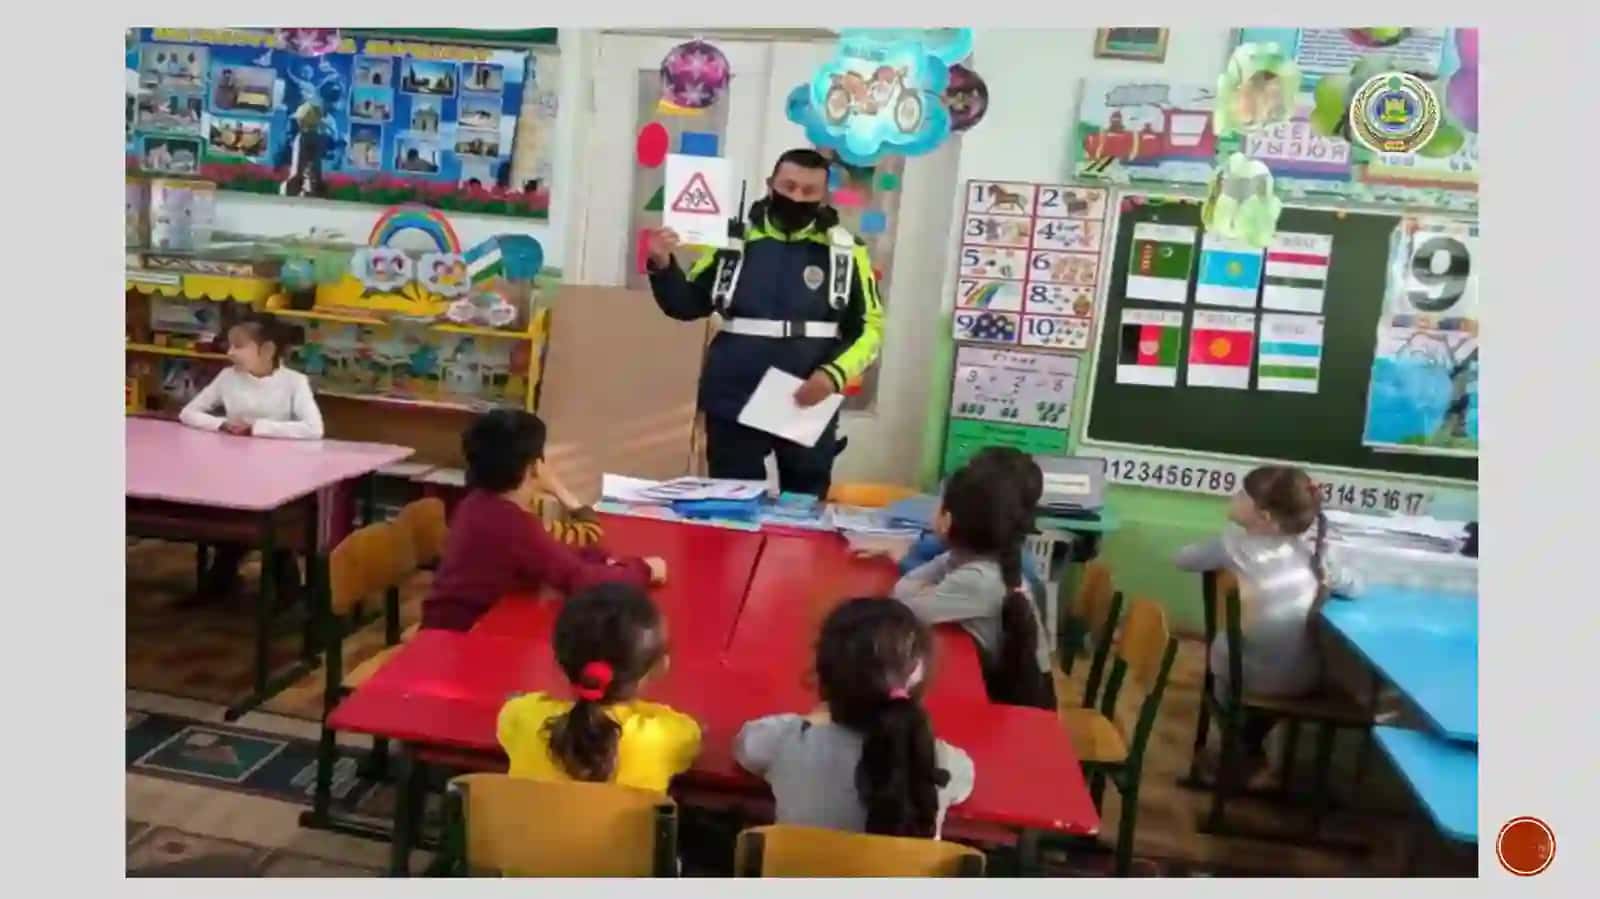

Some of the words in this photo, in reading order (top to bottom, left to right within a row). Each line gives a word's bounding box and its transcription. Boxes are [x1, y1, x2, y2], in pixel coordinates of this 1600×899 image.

[975, 184, 984, 203] 1
[1041, 188, 1059, 208] 2
[966, 217, 984, 237] 3
[1037, 222, 1057, 241] 4
[961, 248, 980, 268] 5
[1032, 252, 1050, 271] 6
[1407, 236, 1471, 312] 9
[960, 279, 979, 298] 7
[1030, 284, 1048, 304] 8
[957, 314, 975, 333] 9
[1025, 317, 1055, 337] 10
[1337, 483, 1356, 505] 14
[1360, 487, 1378, 509] 15
[1383, 489, 1401, 512] 16
[1404, 492, 1425, 516] 17
